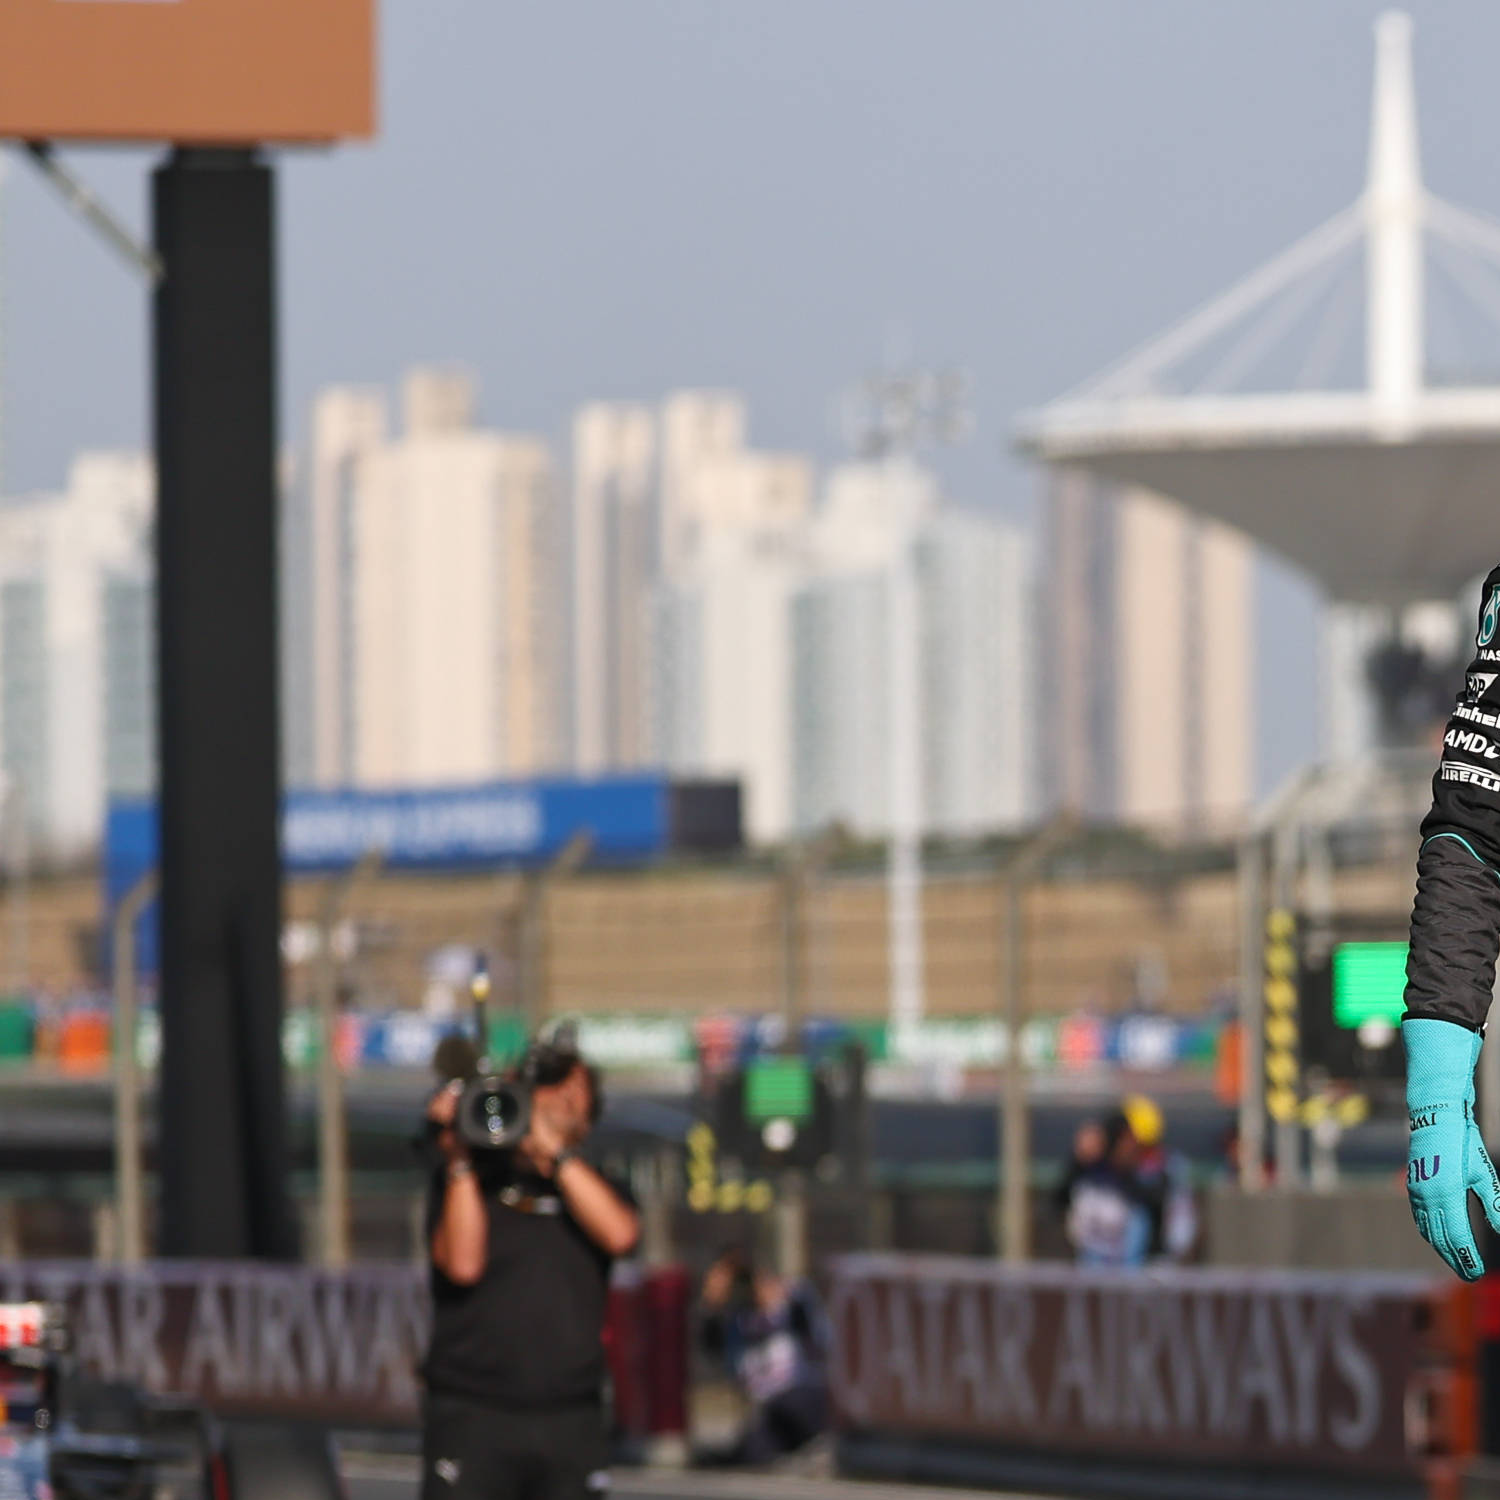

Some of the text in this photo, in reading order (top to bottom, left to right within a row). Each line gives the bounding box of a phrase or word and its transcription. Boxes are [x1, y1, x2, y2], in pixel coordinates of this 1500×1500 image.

[1444, 729, 1488, 755] AMD
[1478, 1147, 1500, 1194] WhatsApp
[1458, 1247, 1475, 1270] OMP
[1052, 1288, 1382, 1454] AIRWAYS
